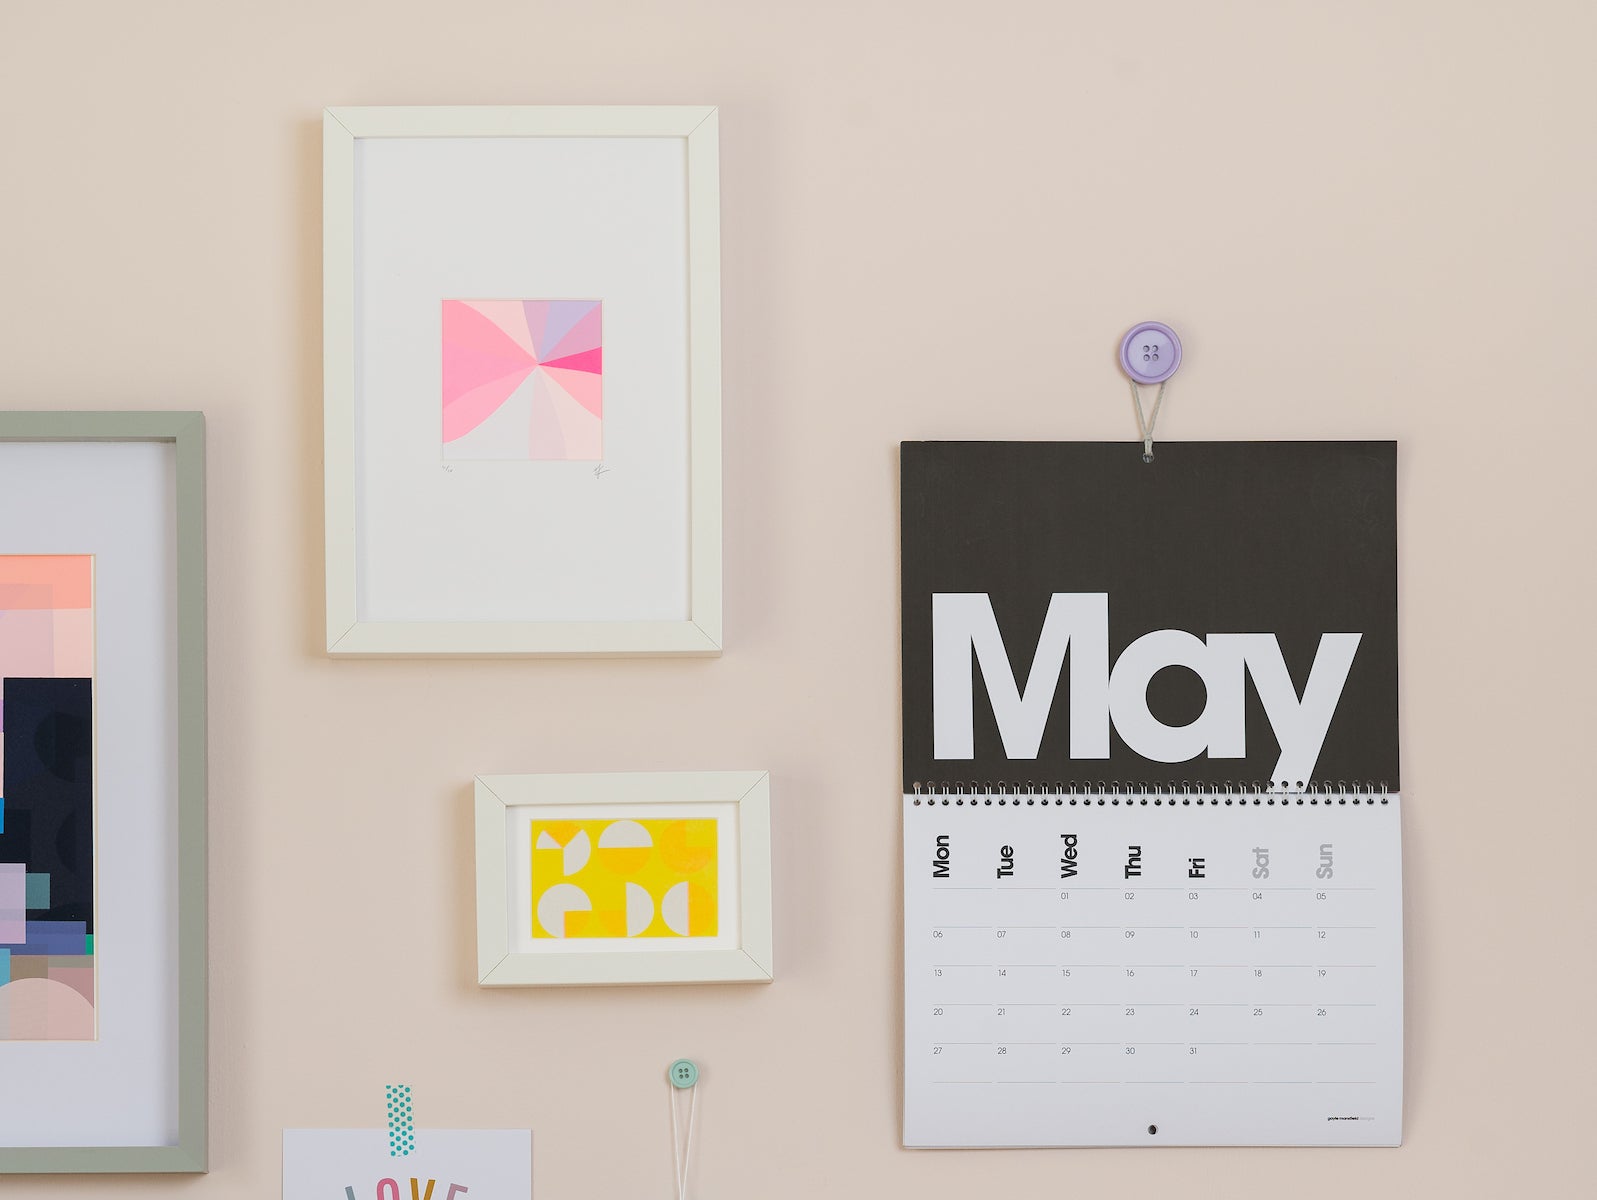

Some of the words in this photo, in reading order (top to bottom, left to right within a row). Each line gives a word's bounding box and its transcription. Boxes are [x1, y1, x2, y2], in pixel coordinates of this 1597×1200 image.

[931, 592, 1363, 793] May
[932, 834, 950, 878] Mon
[996, 844, 1015, 880] Tue
[1060, 833, 1079, 879] Wed
[1124, 845, 1142, 880] Thu
[1187, 857, 1206, 879] Fri
[1252, 846, 1270, 880] Sat
[1315, 843, 1334, 880] Sun
[1060, 891, 1069, 901] 01
[1124, 891, 1135, 901] 02
[1188, 891, 1200, 901] 03
[1252, 891, 1263, 901] 04
[1315, 891, 1327, 901] 05
[932, 930, 944, 939] 06
[996, 930, 1007, 939] 07
[1060, 930, 1072, 939] 08
[1124, 930, 1136, 939] 09
[1189, 930, 1199, 939] 10
[1253, 930, 1261, 939] 11
[1317, 930, 1327, 939] 12
[934, 969, 943, 978] 13
[997, 969, 1007, 978] 14
[1061, 969, 1071, 978] 15
[1125, 969, 1135, 978] 16
[1189, 969, 1199, 978] 17
[1253, 969, 1263, 978] 18
[1317, 969, 1327, 978] 19
[933, 1007, 944, 1016] 20
[997, 1007, 1006, 1016] 21
[1061, 1007, 1072, 1016] 22
[1125, 1007, 1136, 1016] 23
[1189, 1007, 1199, 1016] 24
[1252, 1007, 1264, 1016] 25
[1316, 1007, 1327, 1016] 26
[933, 1046, 943, 1056] 27
[997, 1046, 1007, 1056] 28
[1061, 1046, 1072, 1056] 29
[1125, 1046, 1136, 1056] 30
[1188, 1046, 1197, 1056] 31
